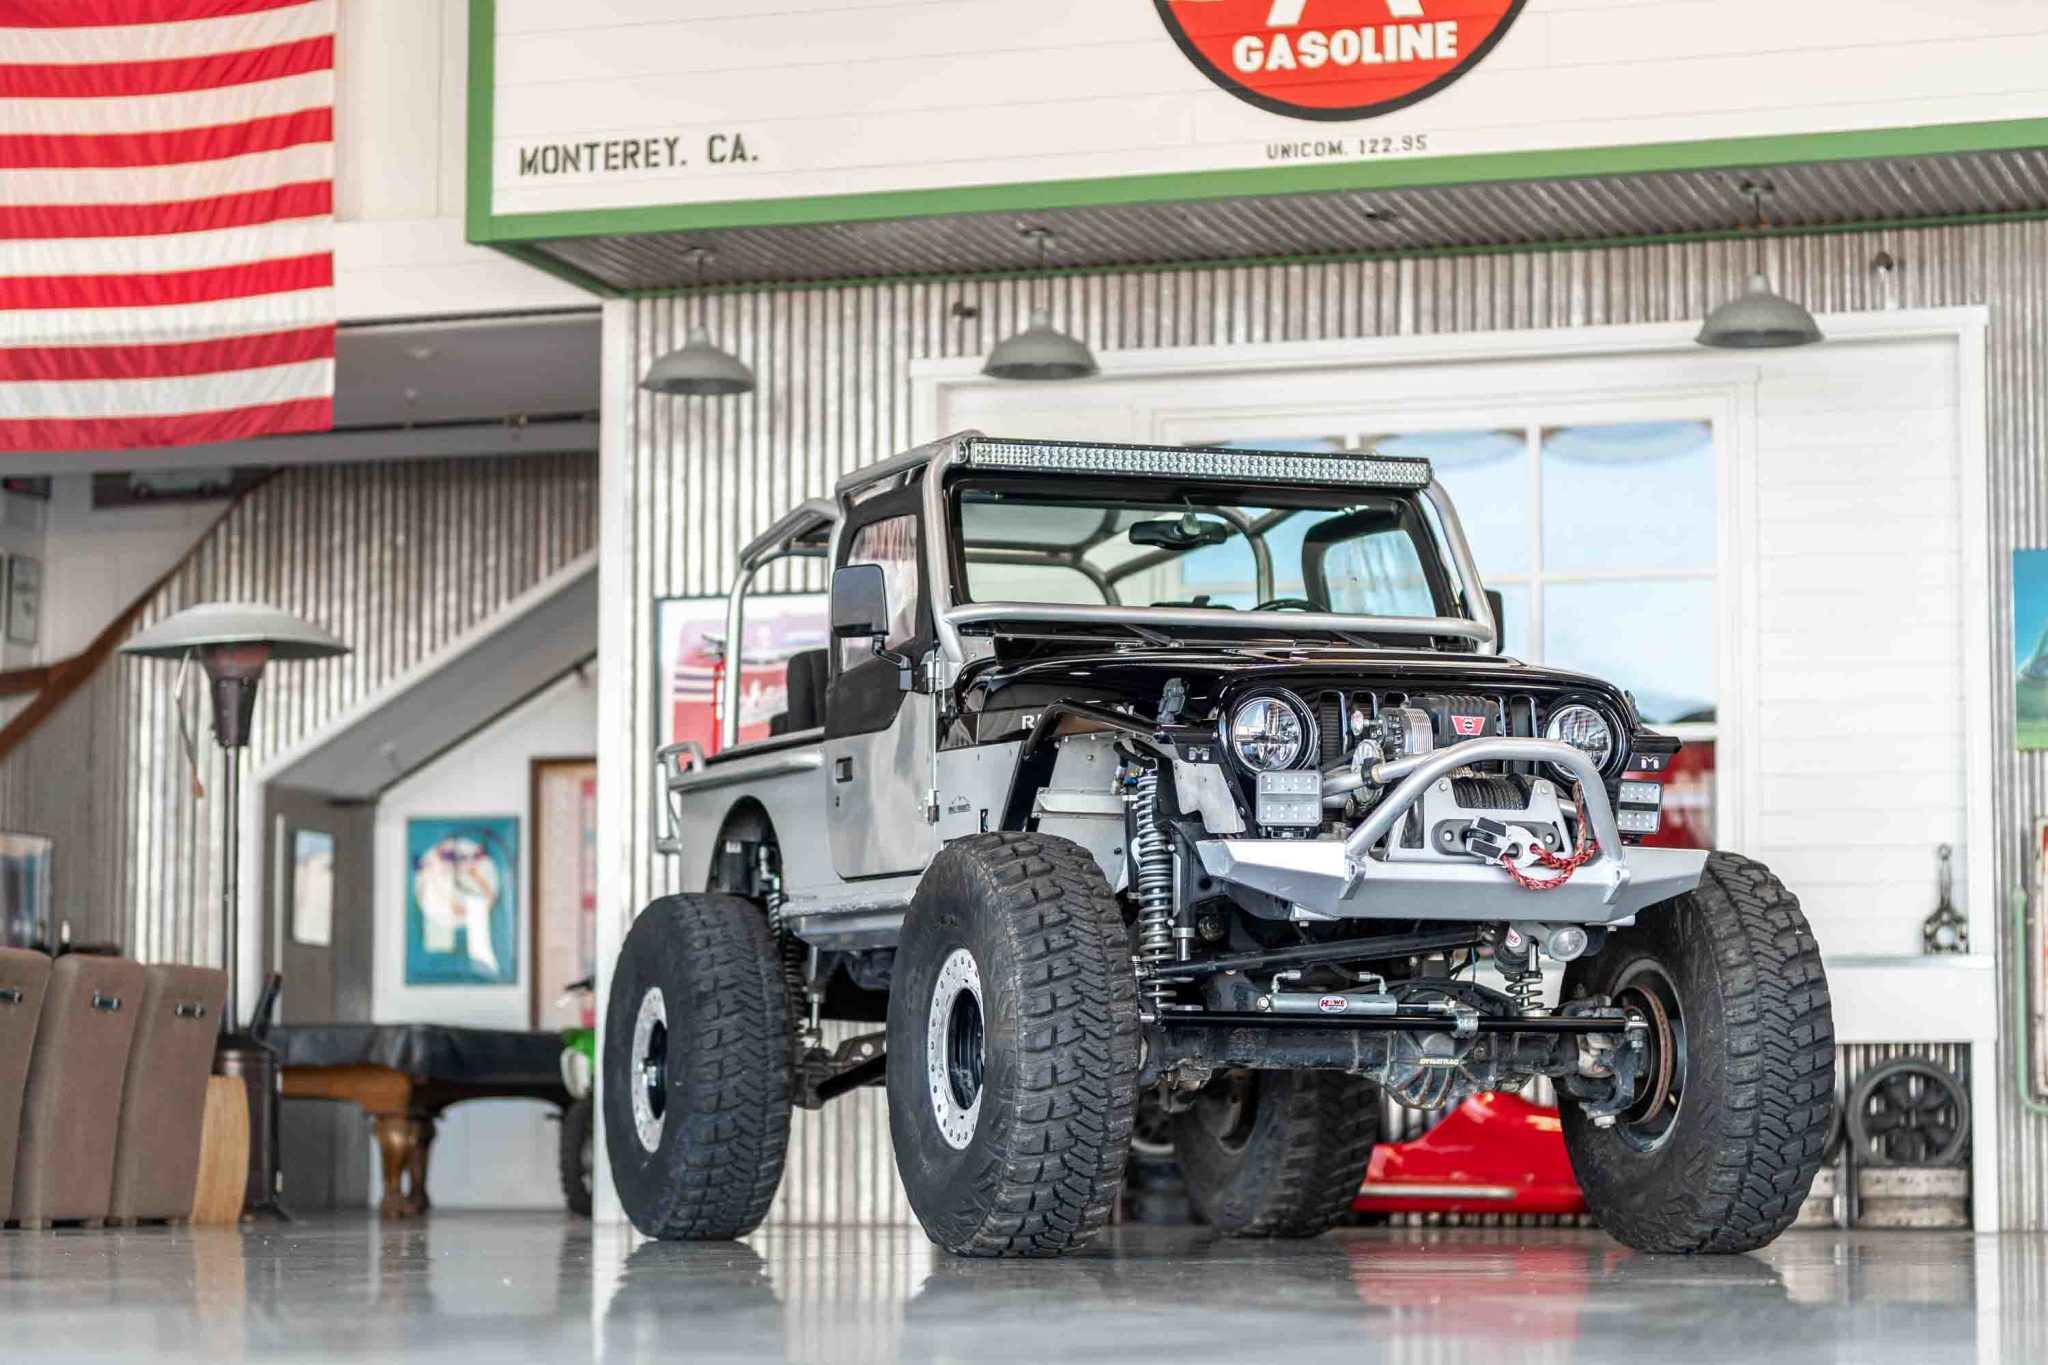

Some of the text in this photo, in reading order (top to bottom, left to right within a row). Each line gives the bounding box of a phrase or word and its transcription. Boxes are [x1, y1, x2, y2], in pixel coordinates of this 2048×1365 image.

[1233, 21, 1458, 72] GASOLINE
[707, 132, 759, 164] CA.
[1359, 134, 1428, 155] 122.95
